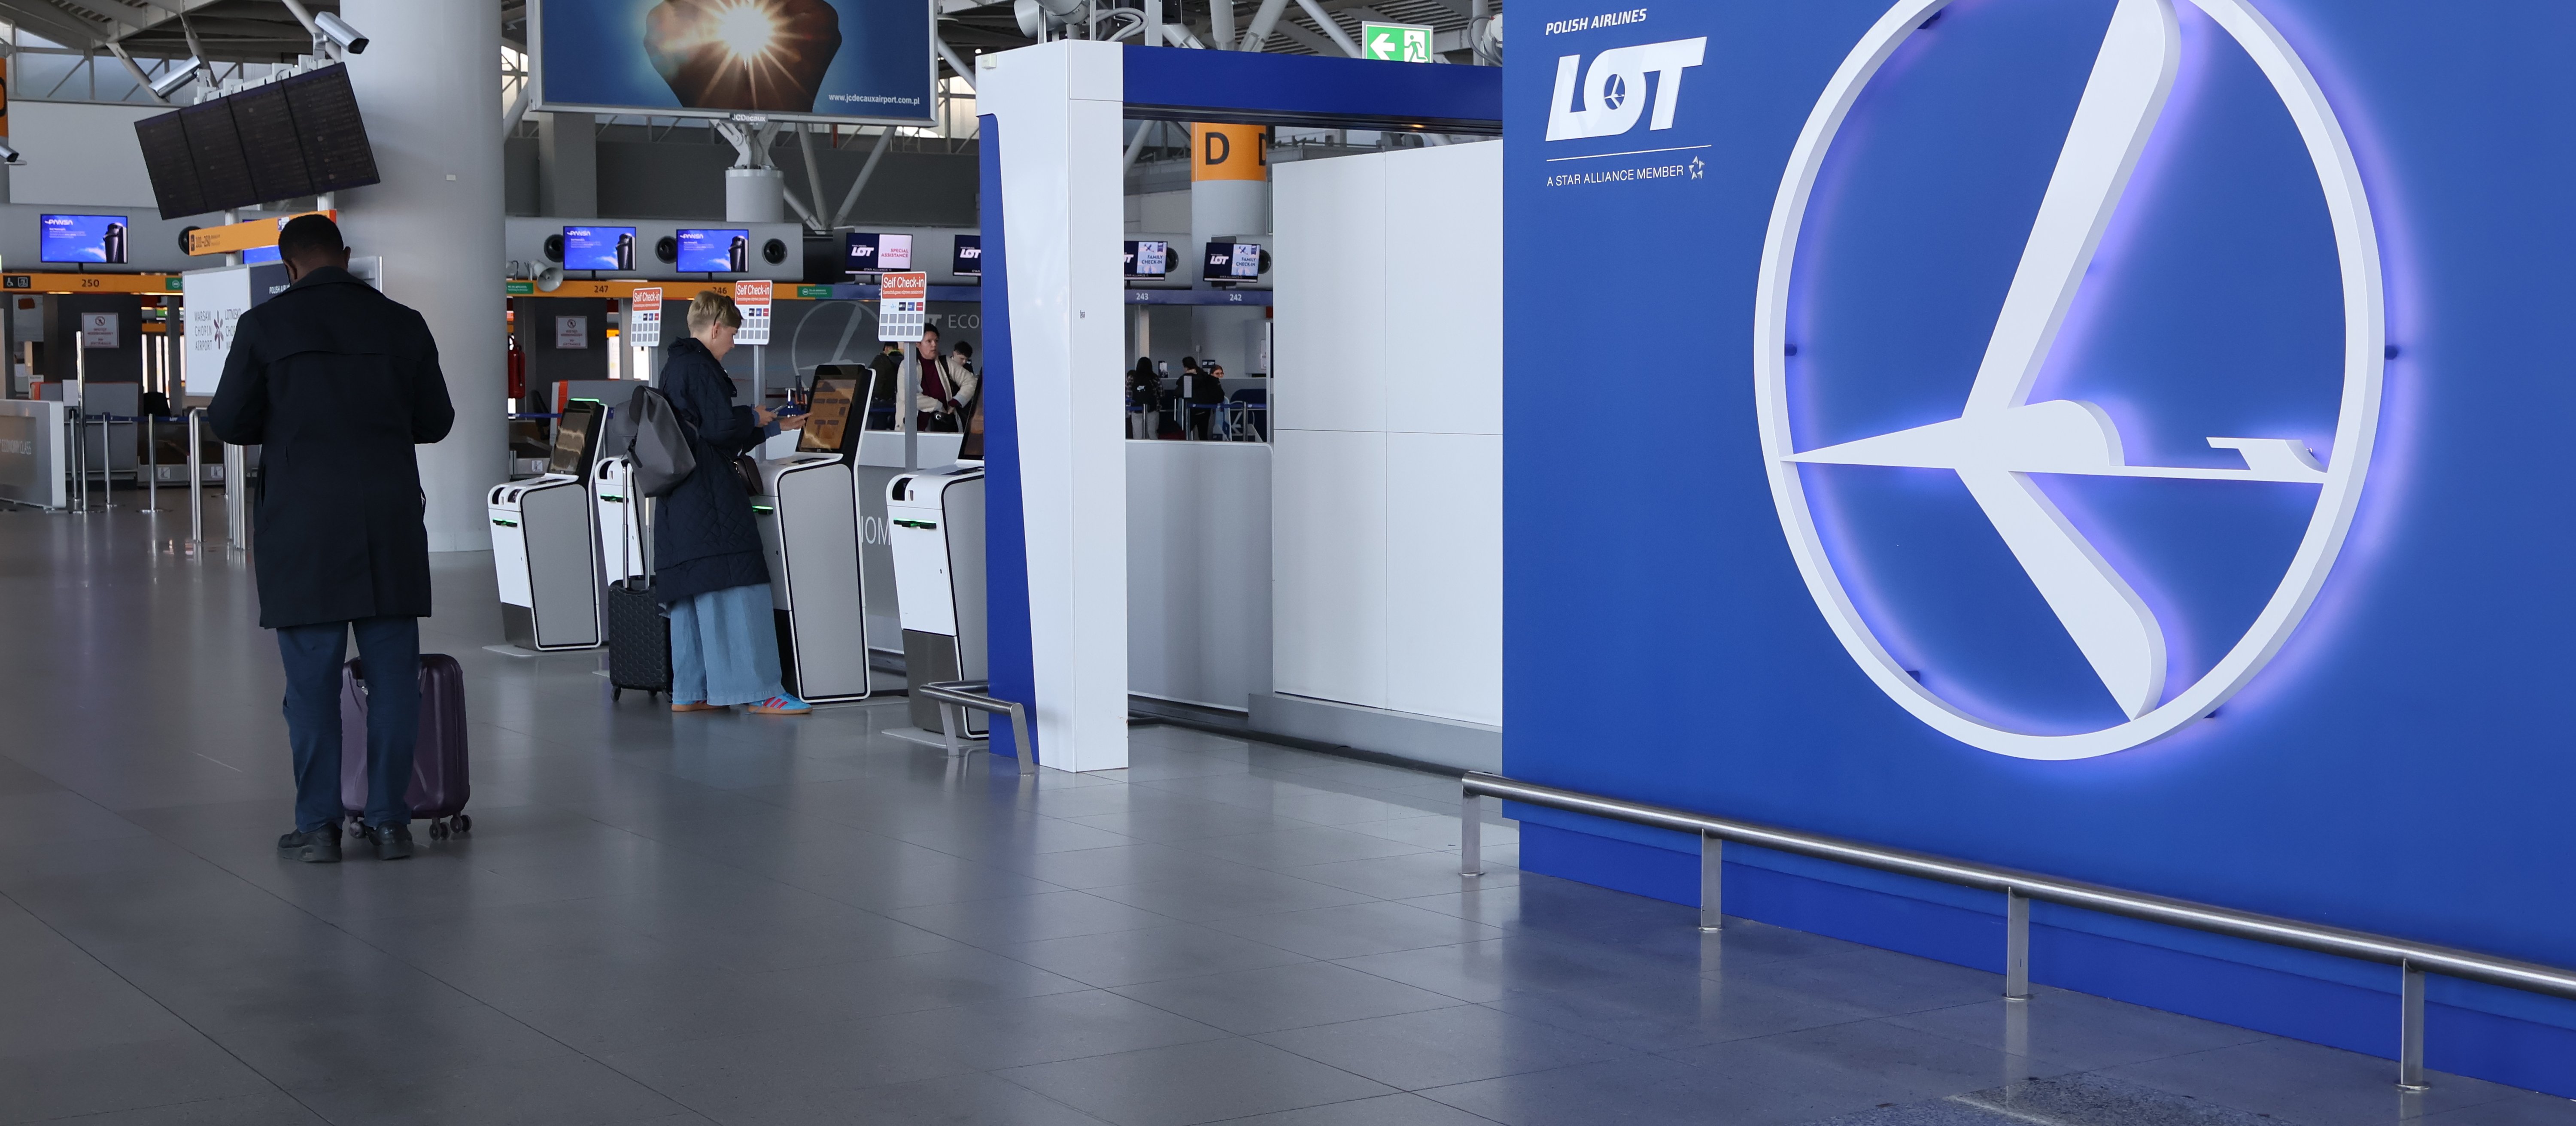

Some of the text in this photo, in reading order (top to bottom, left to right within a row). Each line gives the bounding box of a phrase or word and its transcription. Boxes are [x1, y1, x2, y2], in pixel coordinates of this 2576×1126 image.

[1546, 8, 1647, 35] POLISH AIRLINES
[1546, 36, 1707, 142] LOT
[828, 93, 920, 106] www.jcdecauxairport.com.pl
[1206, 132, 1230, 165] D
[1547, 165, 1683, 187] A STAR ALLIANCE MEMBER
[851, 247, 874, 257] LOT
[960, 249, 981, 258] LOT
[1210, 255, 1229, 264] LOT
[81, 279, 100, 287] 250
[884, 276, 924, 288] Self Check-in
[737, 284, 769, 295] Self Check-in
[634, 291, 660, 302] Self Check-in
[194, 311, 211, 321] WARSAW
[195, 325, 212, 336] CHOPIN
[195, 340, 212, 351] AIRPORT
